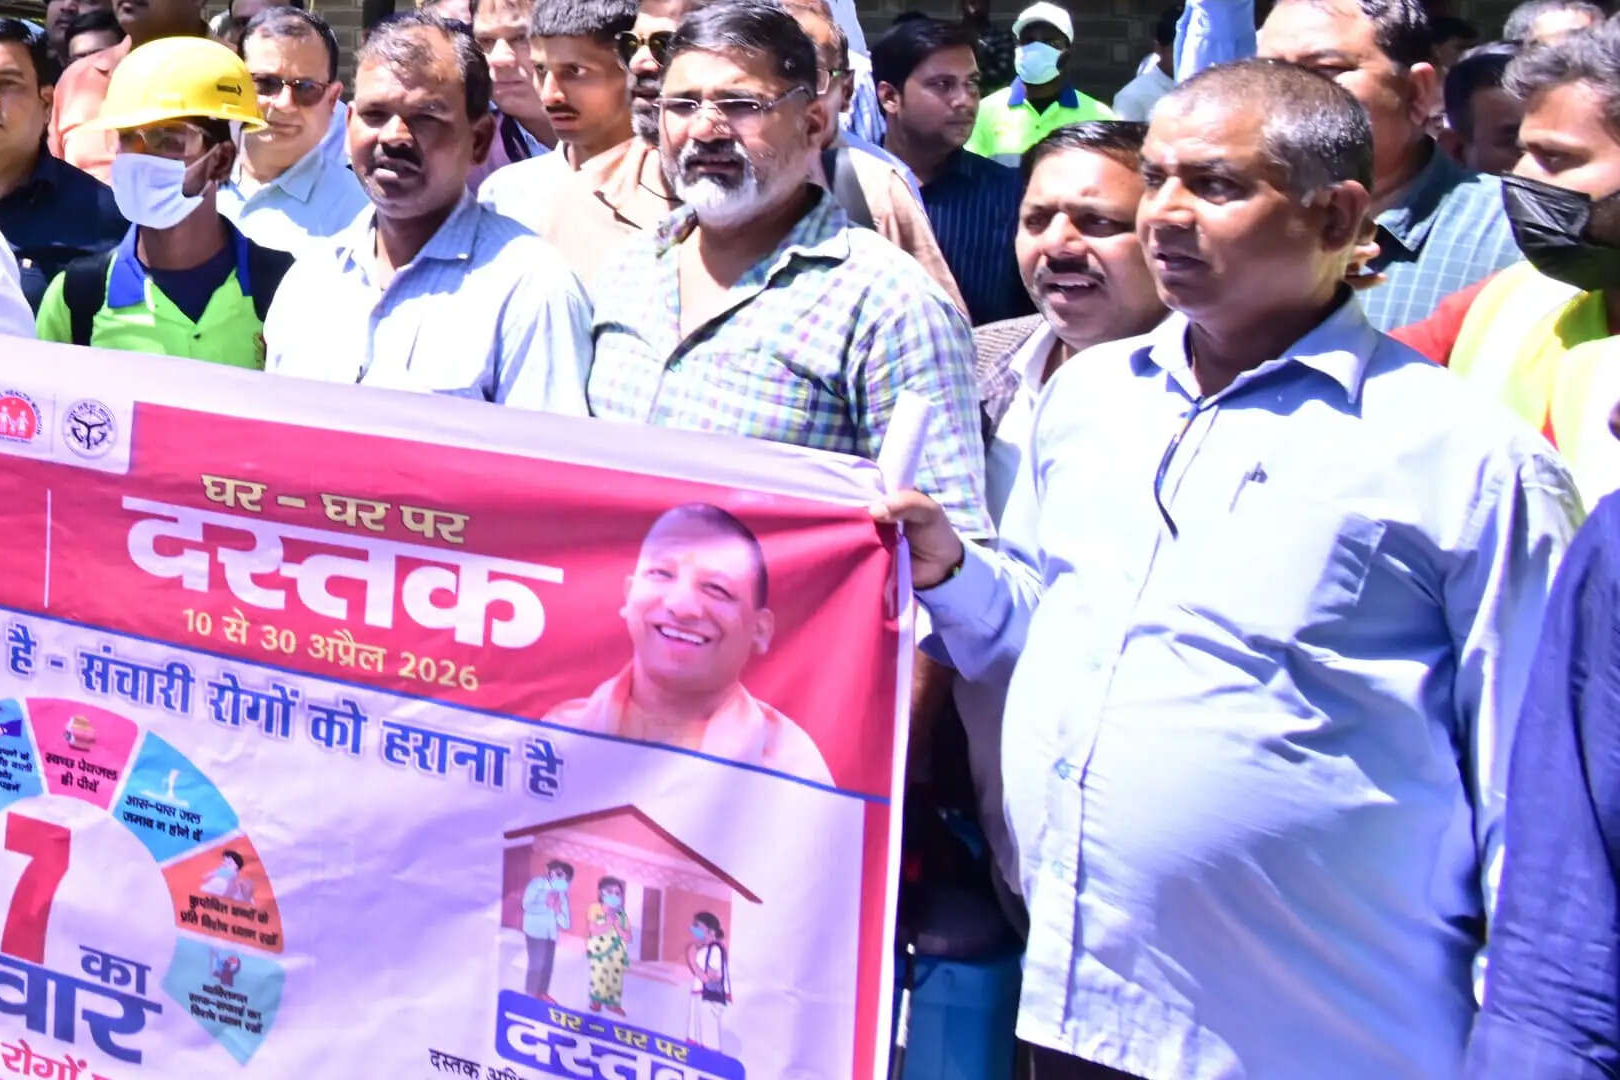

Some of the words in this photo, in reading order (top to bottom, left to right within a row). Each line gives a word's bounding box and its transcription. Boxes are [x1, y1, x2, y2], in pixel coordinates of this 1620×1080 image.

[200, 472, 267, 510] घर
[320, 492, 390, 531] घर
[400, 504, 470, 545] पर
[121, 495, 565, 650] दस्तक
[182, 608, 212, 637] 10
[221, 607, 252, 646] से
[261, 625, 296, 654] 30
[307, 629, 386, 673] अप्रैल
[398, 652, 480, 692] 2026
[7, 623, 37, 675] है
[80, 647, 195, 715] संचारी
[208, 673, 299, 738] रोगों
[308, 699, 368, 757] को
[382, 720, 510, 788] हराना
[526, 738, 565, 797] है
[0, 811, 71, 965] 7
[78, 945, 152, 995] का
[428, 1048, 481, 1080] दस्तक
